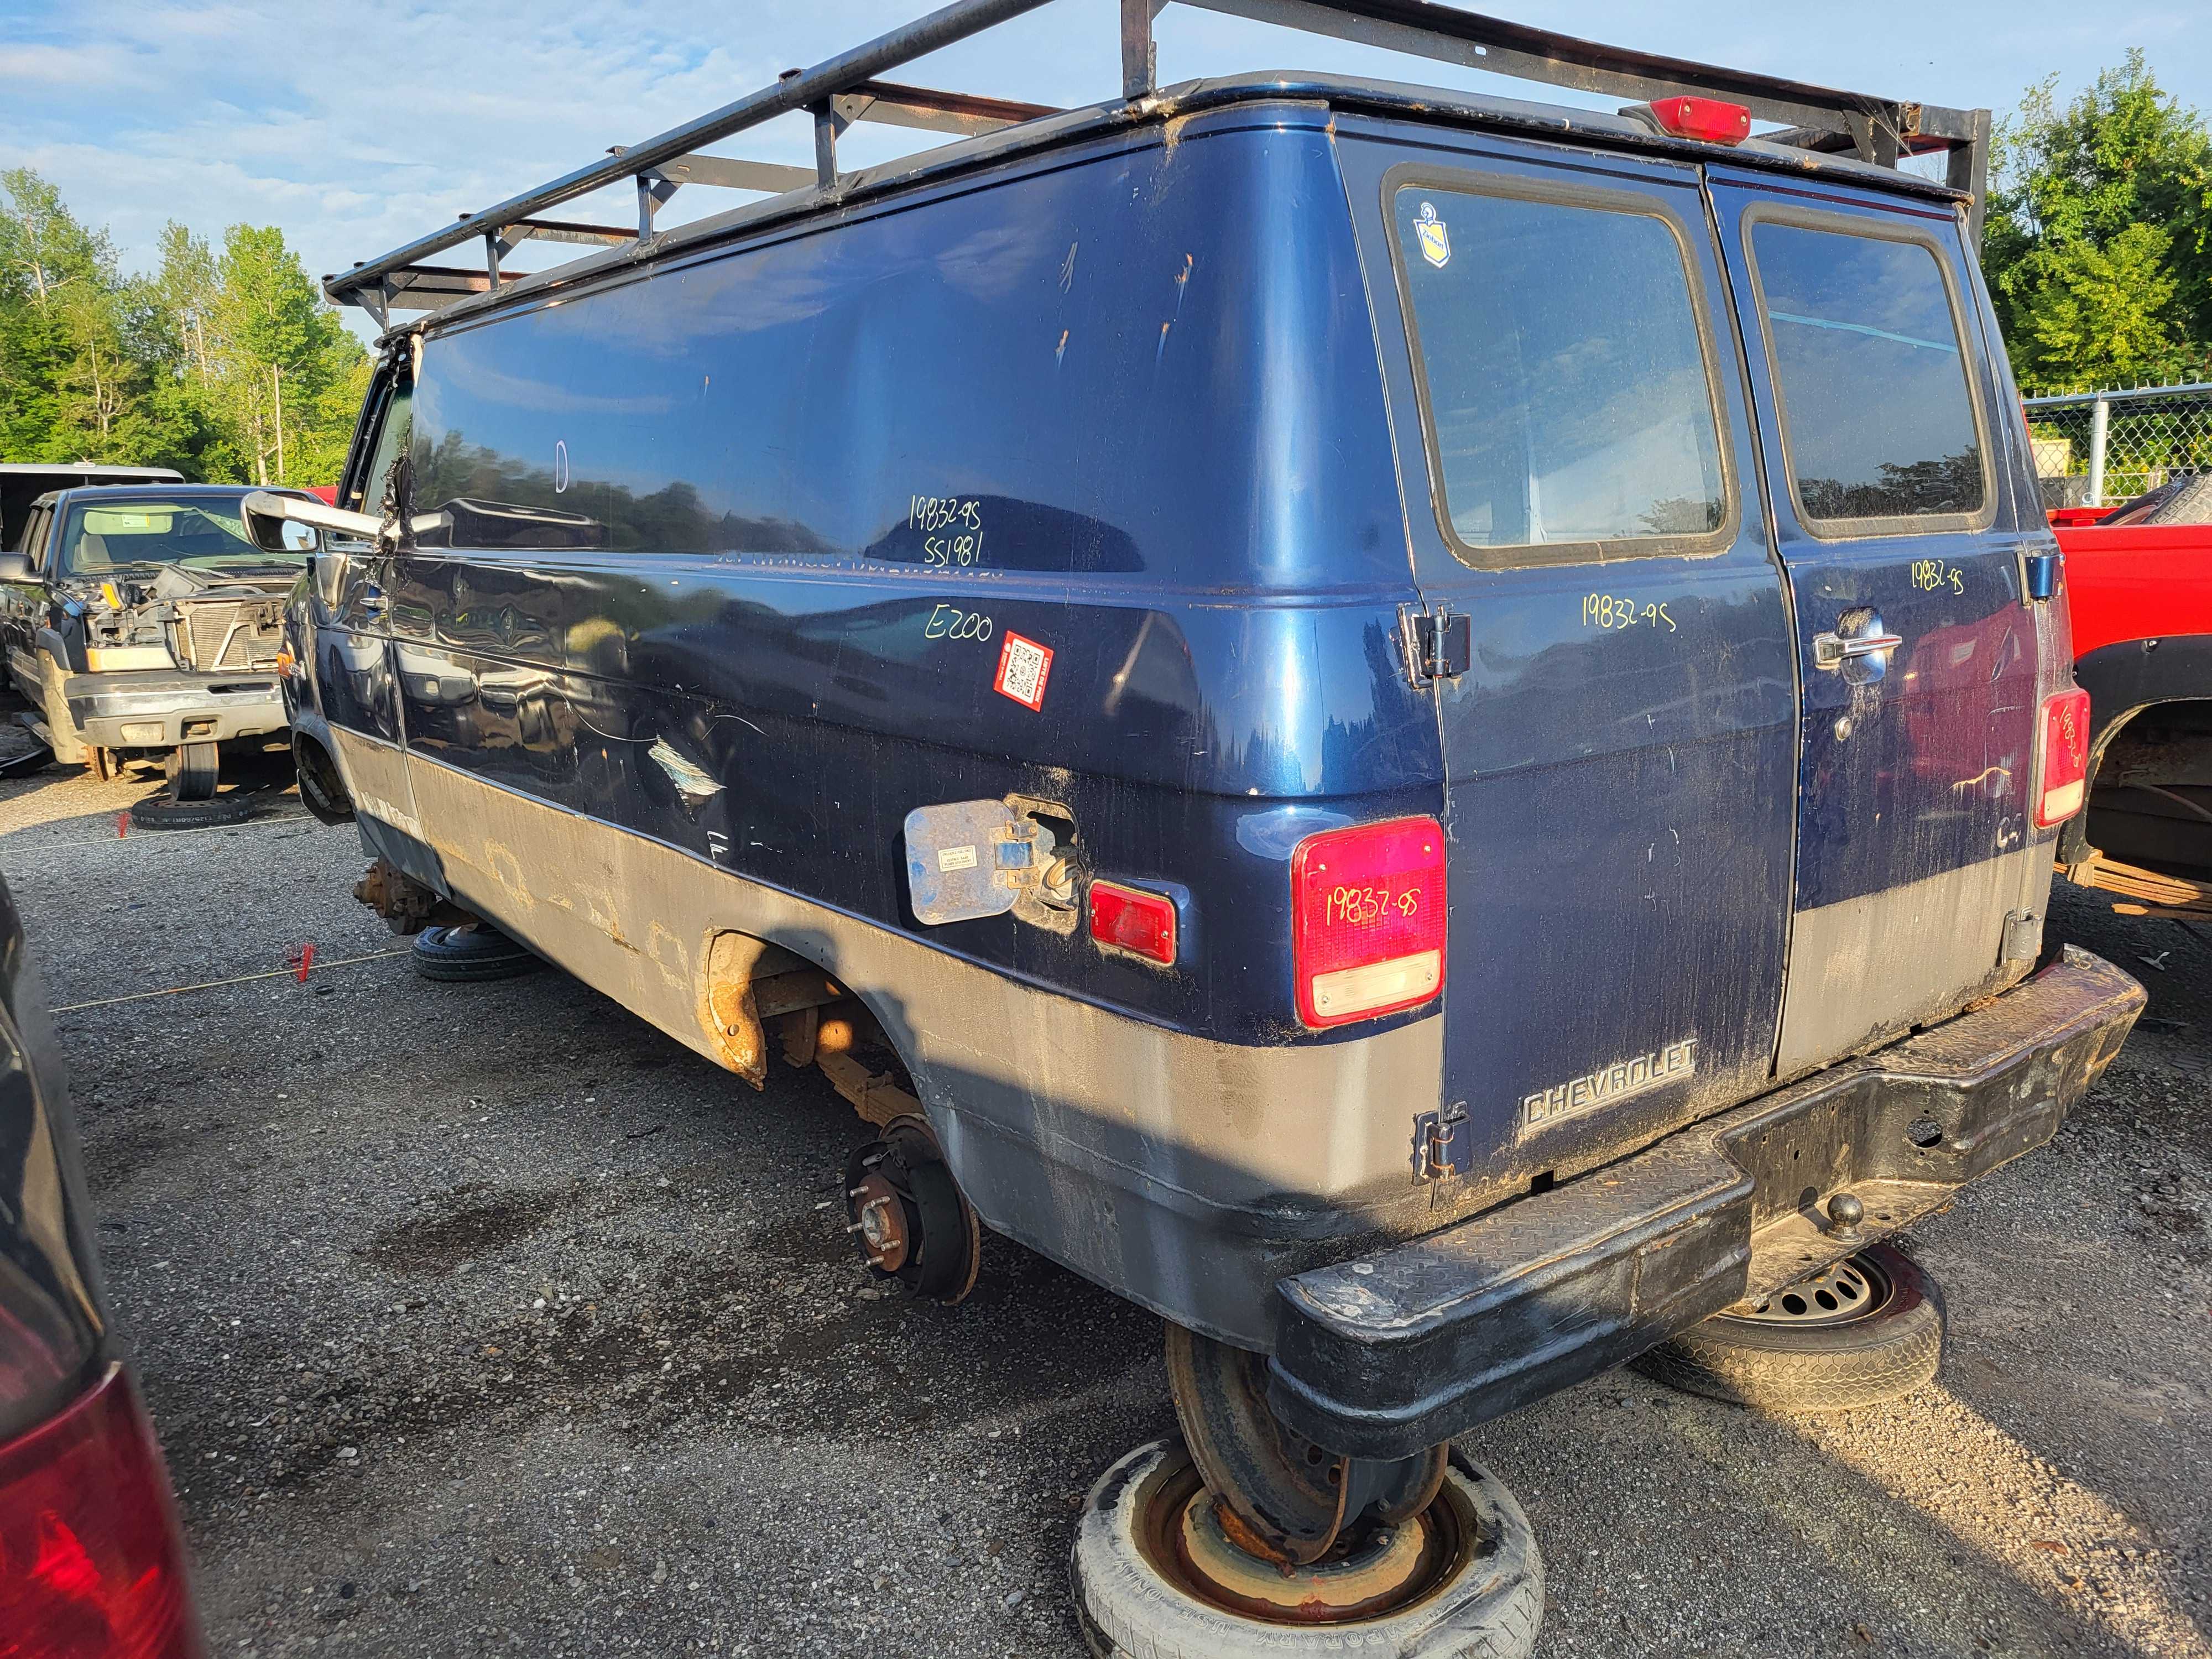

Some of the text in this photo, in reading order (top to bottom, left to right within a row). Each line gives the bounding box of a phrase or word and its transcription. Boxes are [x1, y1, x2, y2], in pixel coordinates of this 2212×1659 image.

[925, 604, 992, 641] E200
[1039, 676, 1045, 685] DE
[1041, 658, 1050, 677] LISTE
[1522, 1038, 1698, 1131] CHEVROLET
[1113, 1559, 1439, 1650] TEMPORARY USE ONLY
